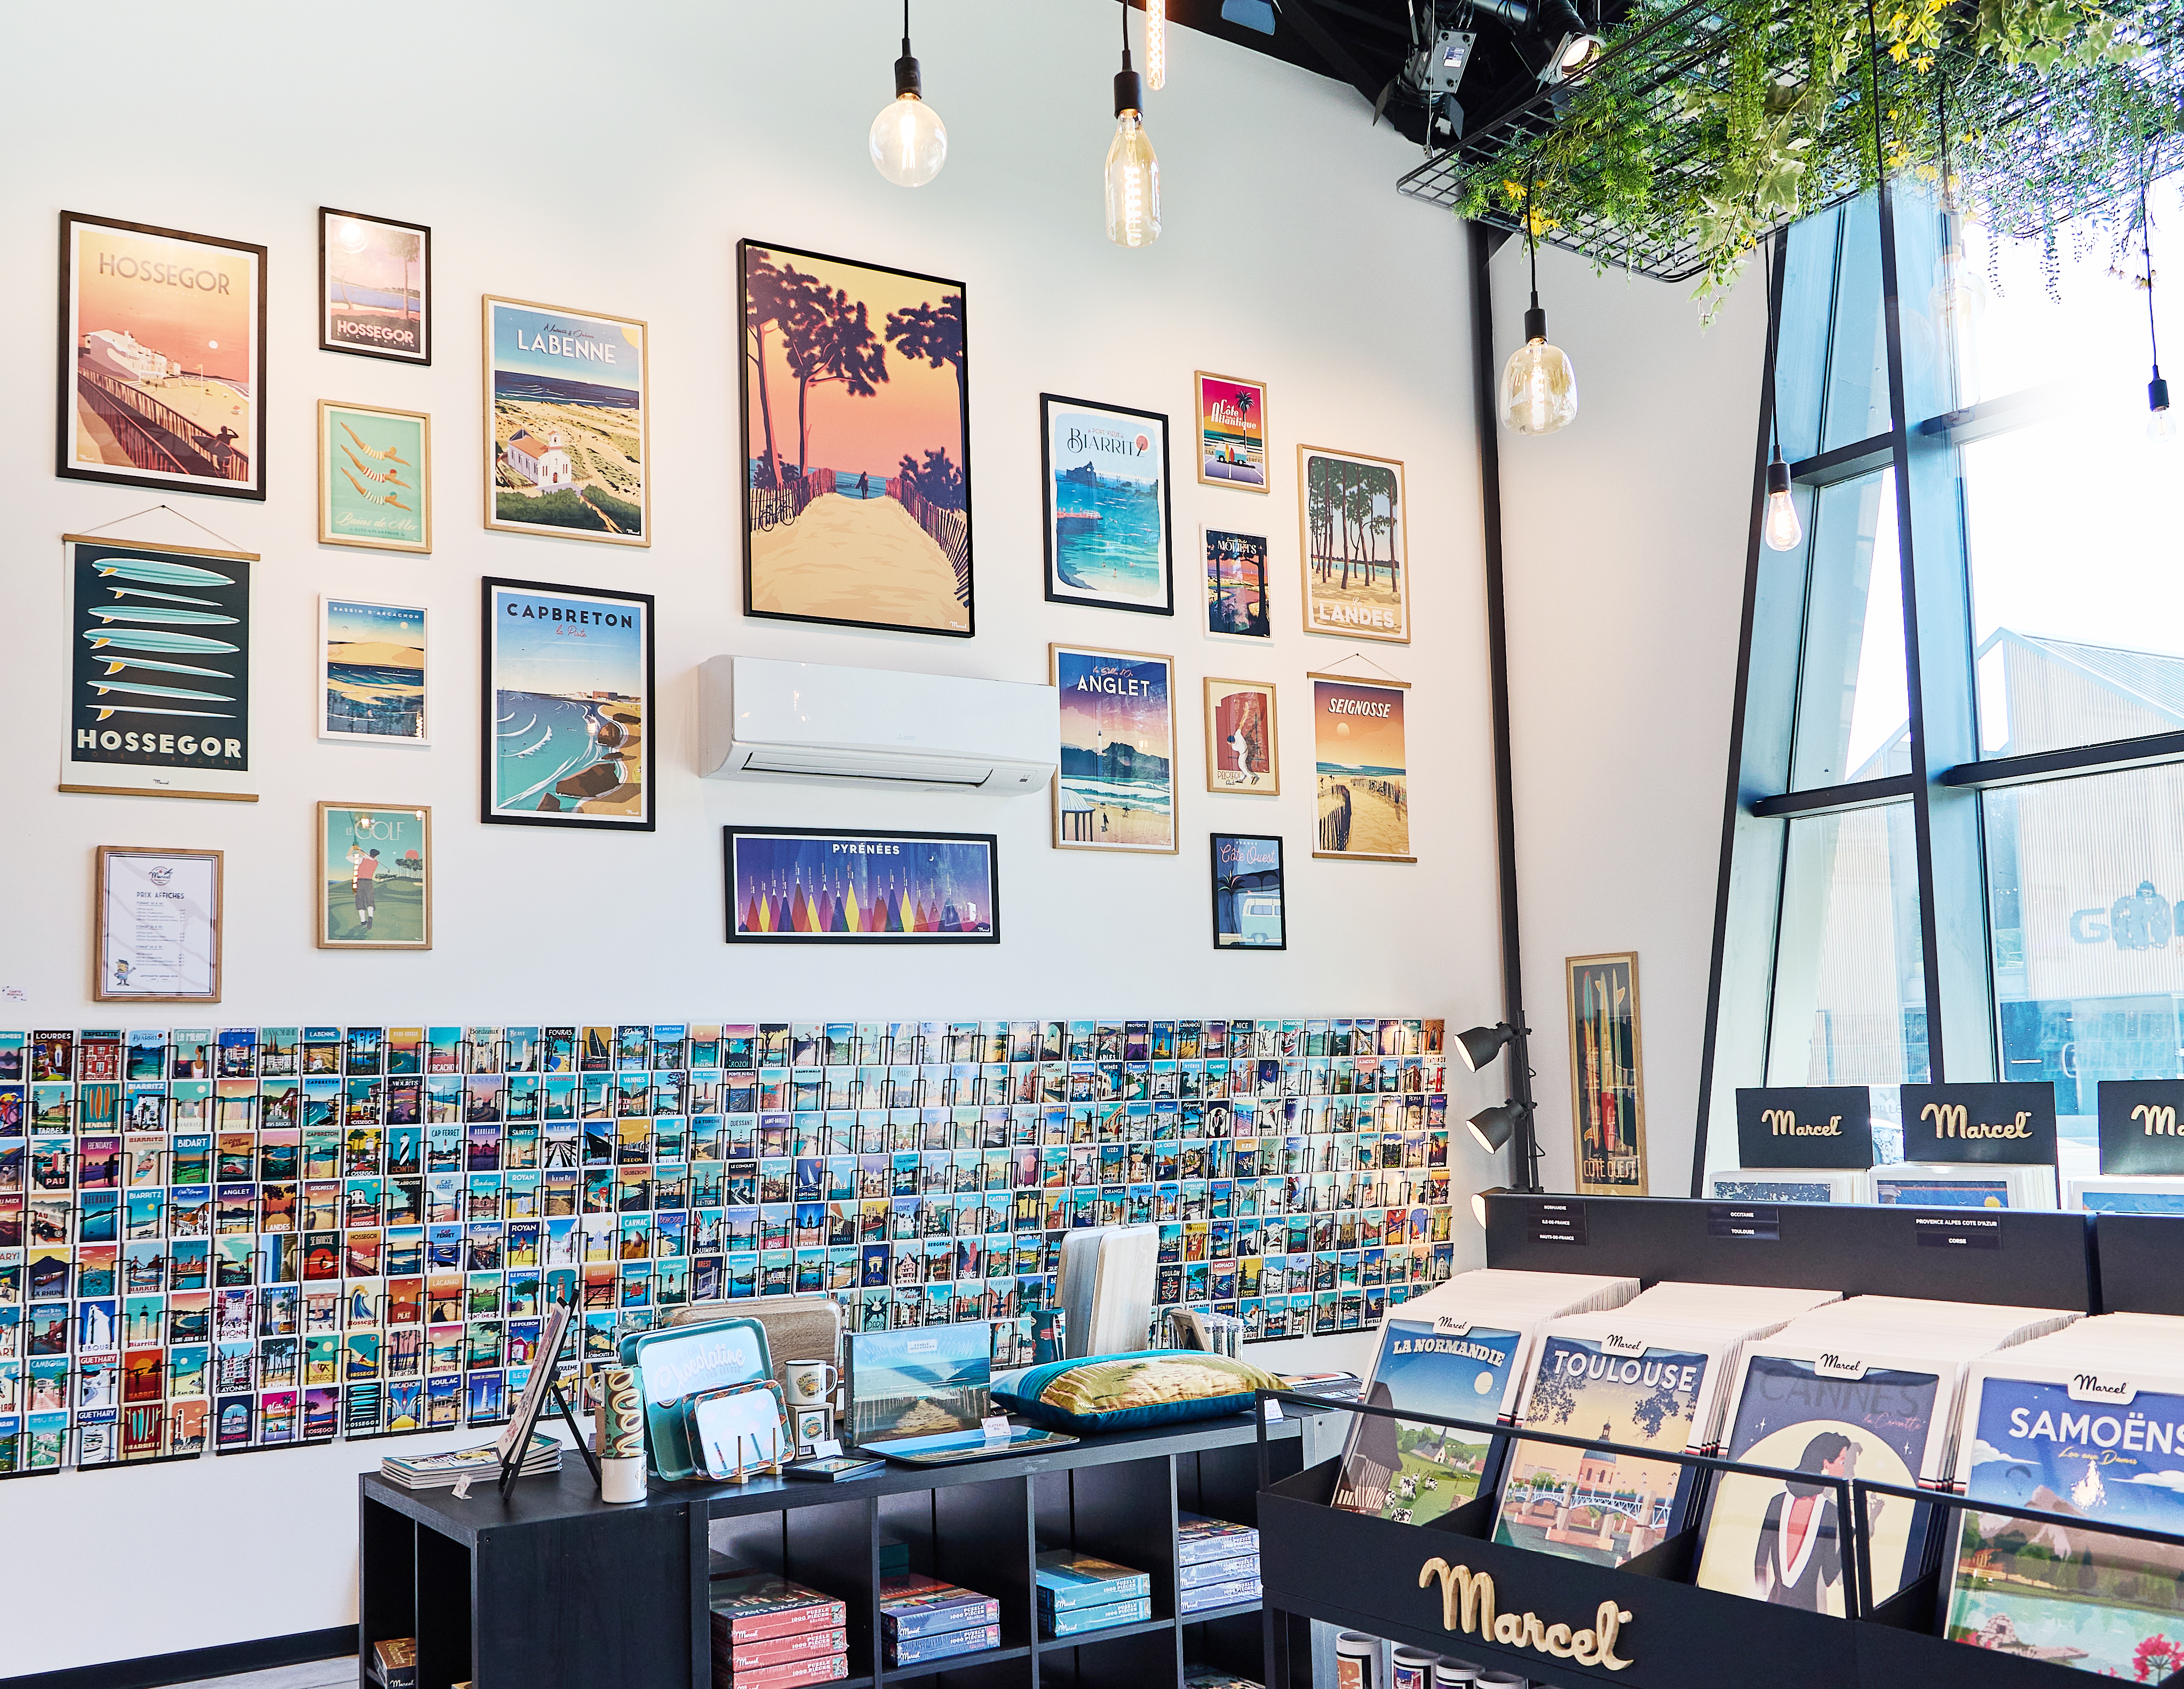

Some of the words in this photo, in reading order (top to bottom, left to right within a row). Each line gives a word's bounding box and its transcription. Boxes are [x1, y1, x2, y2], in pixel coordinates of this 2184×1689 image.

[100, 252, 230, 295] HOSSEGOR
[337, 320, 414, 344] HOSSEGOR
[518, 329, 616, 364] LABENNE
[1211, 402, 1257, 429] Atlantique
[1220, 400, 1239, 417] Côte
[1067, 428, 1145, 458] BIARRITZ
[335, 511, 372, 527] Bains
[374, 517, 386, 528] de
[388, 518, 418, 531] Mer
[1217, 540, 1257, 554] MOLIETS
[368, 610, 419, 619] D'ARCACHON
[507, 603, 632, 628] CAPBRETON
[1319, 603, 1394, 628] LANDES
[950, 620, 967, 629] Marcel
[1077, 674, 1150, 697] ANGLET
[1328, 698, 1391, 718] SEIGNOSSE
[77, 729, 241, 758] HOSSEGOR
[346, 827, 352, 835] LE
[354, 821, 404, 841] GOLF
[832, 843, 900, 855] PYRÉNÉES
[1220, 844, 1245, 863] Côte
[1246, 846, 1275, 864] Ouest
[469, 1027, 498, 1035] Bordeaux
[429, 1064, 459, 1072] ARCACHON
[1761, 1109, 1843, 1137] Marcel
[1920, 1103, 2033, 1140] Marcel
[88, 1142, 113, 1150] HENDAYE
[177, 1138, 207, 1148] BIDART
[511, 1224, 536, 1232] ROYAN
[432, 1278, 459, 1287] LACANAU
[397, 1312, 411, 1320] PILAT
[867, 1320, 885, 1331] PARIS
[1439, 1316, 1467, 1331] Marcel
[1607, 1335, 1642, 1350] Marcel
[81, 1355, 116, 1364] GUETHARY
[1393, 1340, 1412, 1355] LA
[1413, 1339, 1506, 1367] NORMANDIE
[1820, 1353, 1861, 1372] Marcel
[654, 1343, 745, 1409] Chocolatine
[1554, 1350, 1697, 1392] TOULOUSE
[2074, 1374, 2127, 1394] Marcel
[1762, 1376, 1919, 1418] CANNES
[78, 1409, 116, 1419] GUETHARY
[346, 1420, 379, 1428] HOSSEGOR
[1057, 1599, 1076, 1608] Marcel
[1117, 1603, 1137, 1611] PUZZLE
[1419, 1557, 1634, 1671] Marcel
[736, 1630, 758, 1639] Marcel
[900, 1627, 920, 1636] Marcel
[964, 1629, 985, 1637] PUZZLE
[1058, 1624, 1077, 1633] Marcel
[807, 1634, 830, 1642] PUZZLE
[737, 1657, 759, 1667] Marcel
[900, 1651, 920, 1661] Marcel
[807, 1660, 830, 1669] PUZZLE
